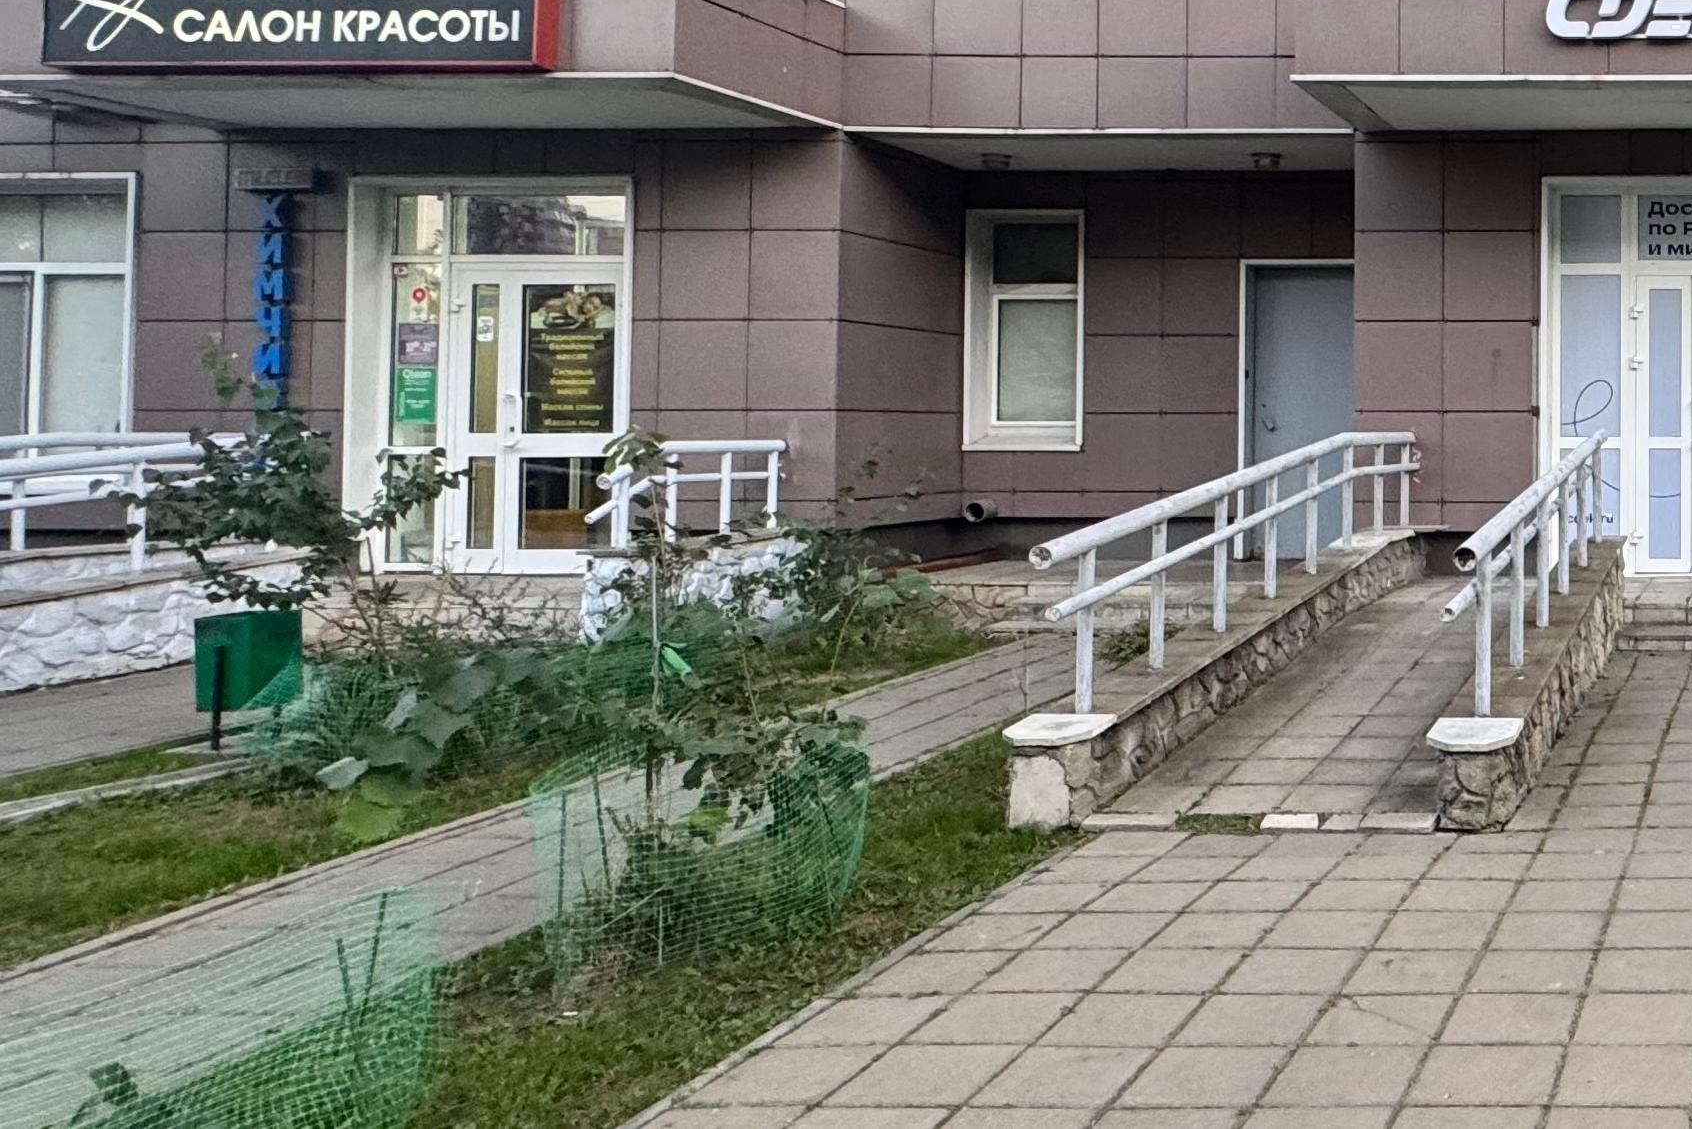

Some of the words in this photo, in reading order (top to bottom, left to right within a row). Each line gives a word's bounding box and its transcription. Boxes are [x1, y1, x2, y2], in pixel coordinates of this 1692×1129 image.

[173, 9, 320, 43] САЛОН
[333, 9, 520, 43] КРАСОТЫ
[1648, 223, 1677, 235] по
[1648, 244, 1661, 255] и
